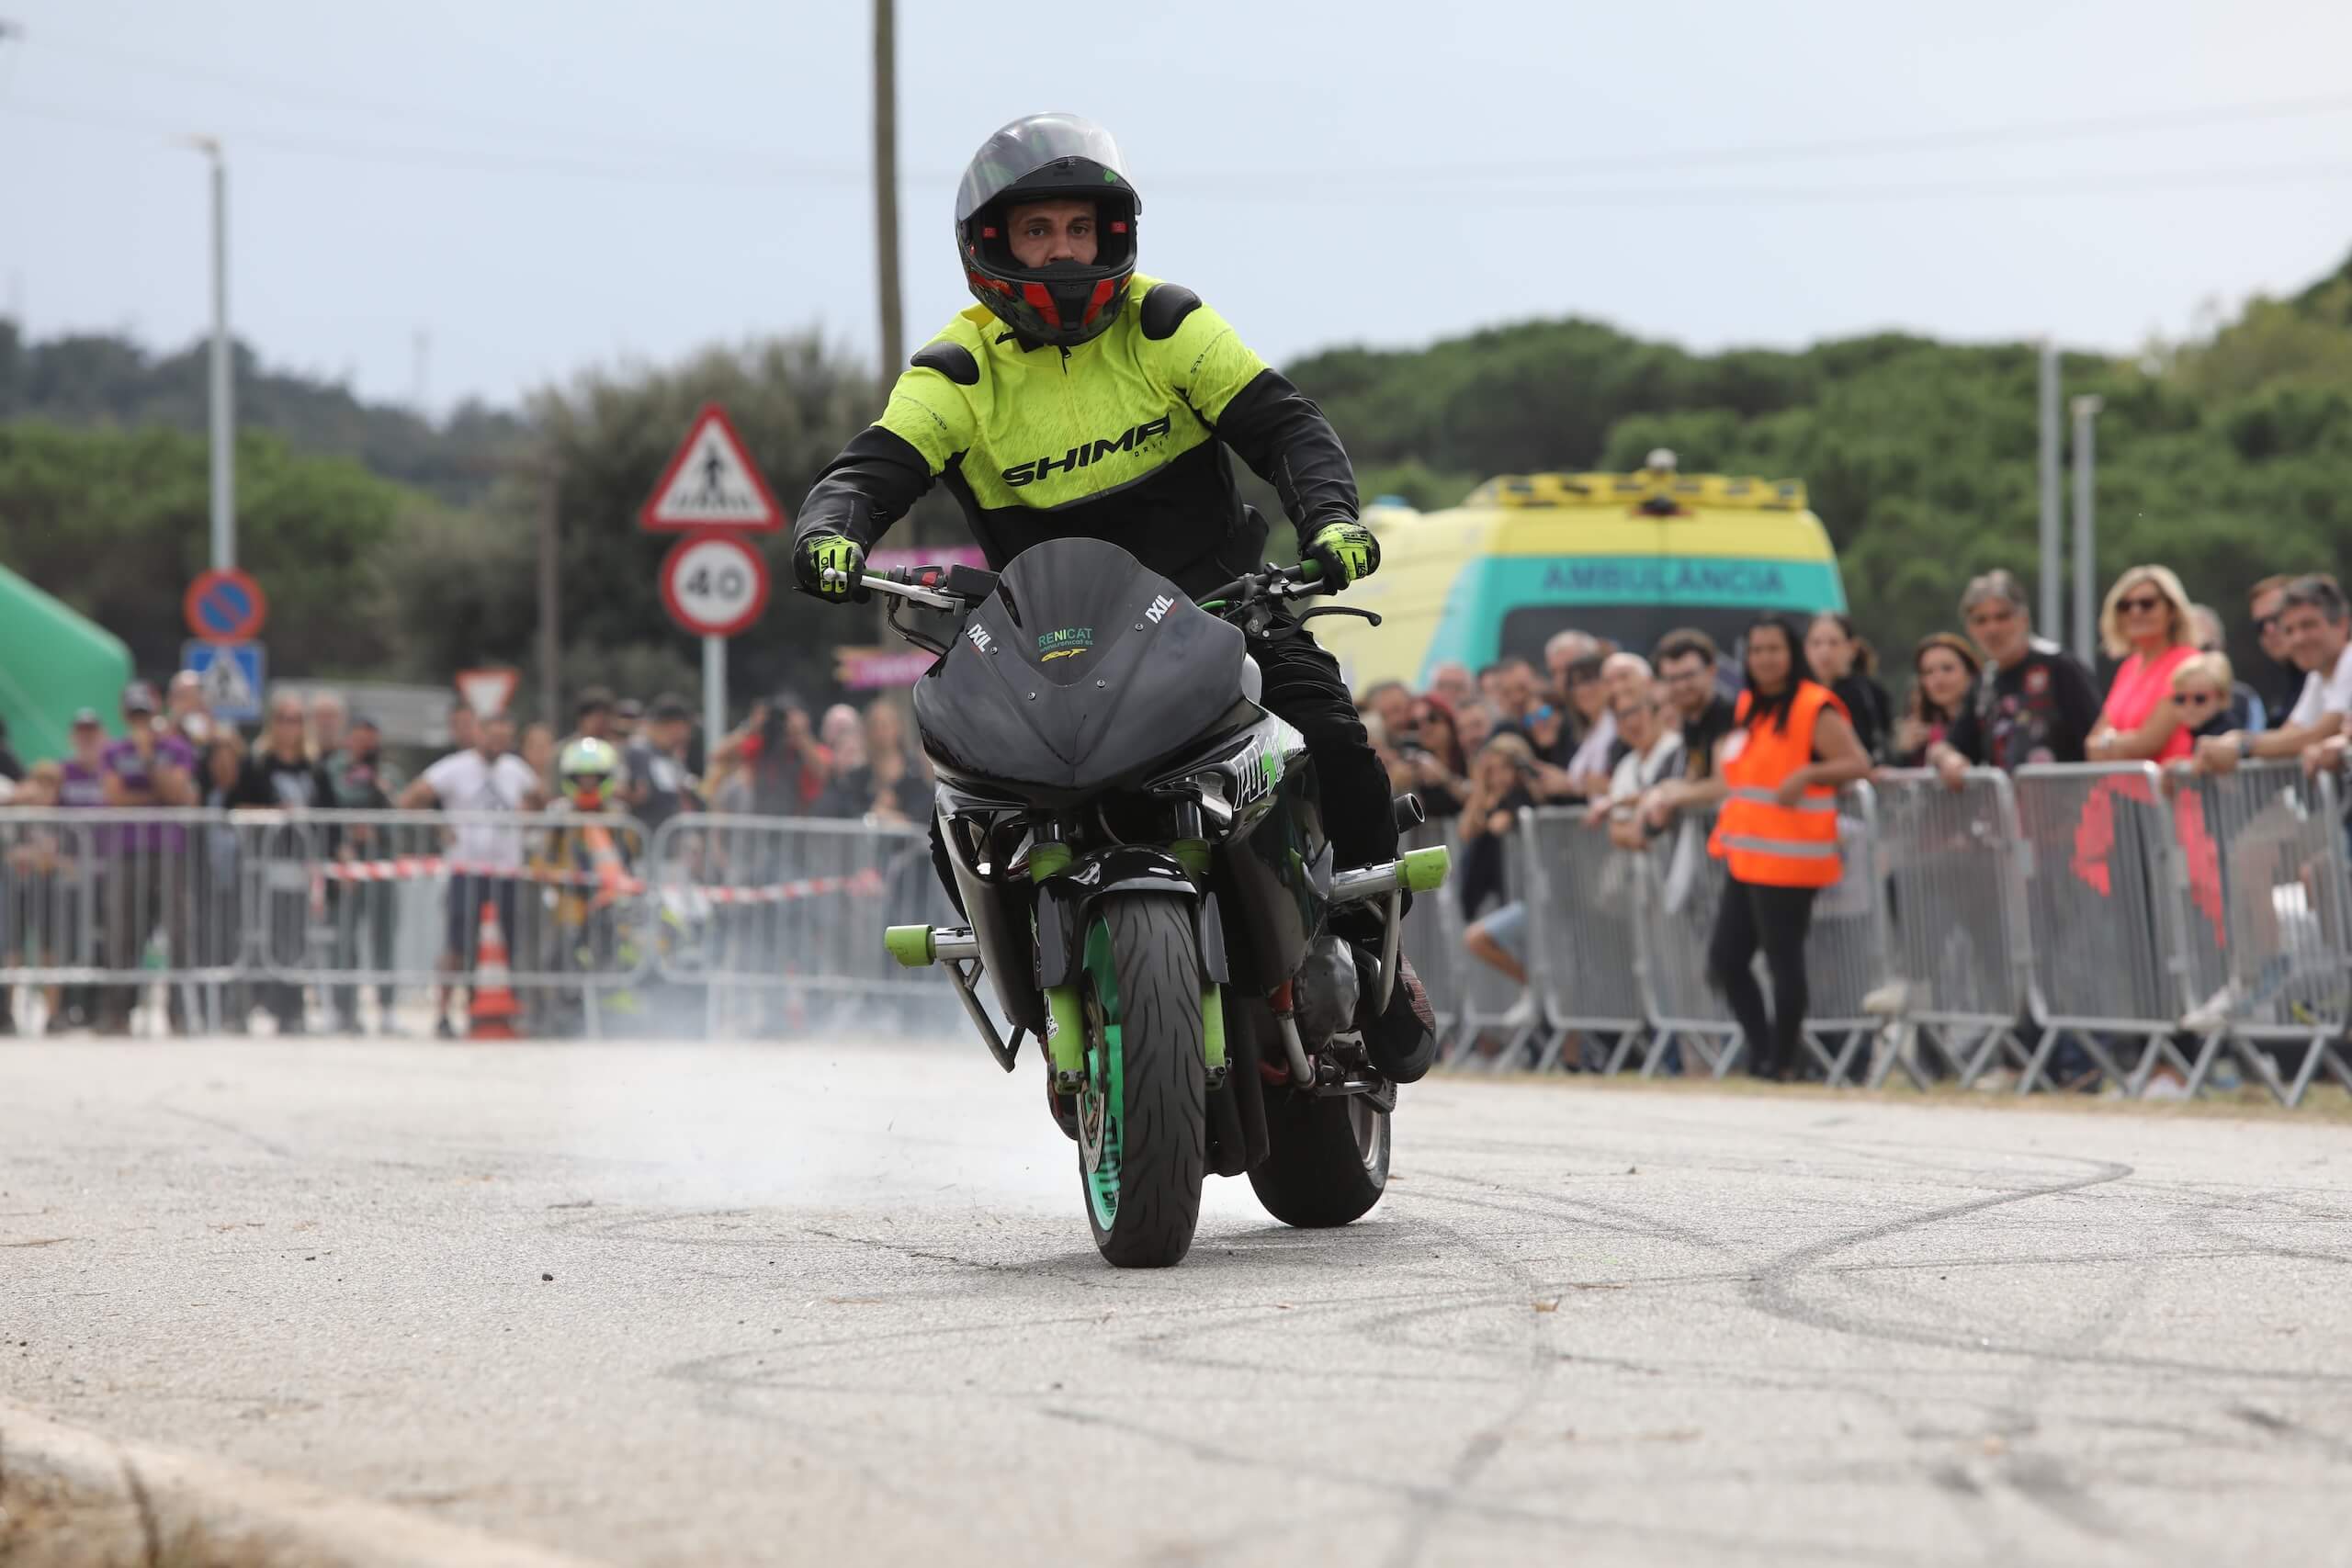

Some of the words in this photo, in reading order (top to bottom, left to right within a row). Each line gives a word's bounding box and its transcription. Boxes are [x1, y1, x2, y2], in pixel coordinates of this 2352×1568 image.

[1001, 412, 1170, 487] SHIMA
[684, 562, 748, 604] 40
[1145, 594, 1175, 624] IXIL
[967, 623, 992, 652] IXIL
[1038, 627, 1093, 648] RENICAT
